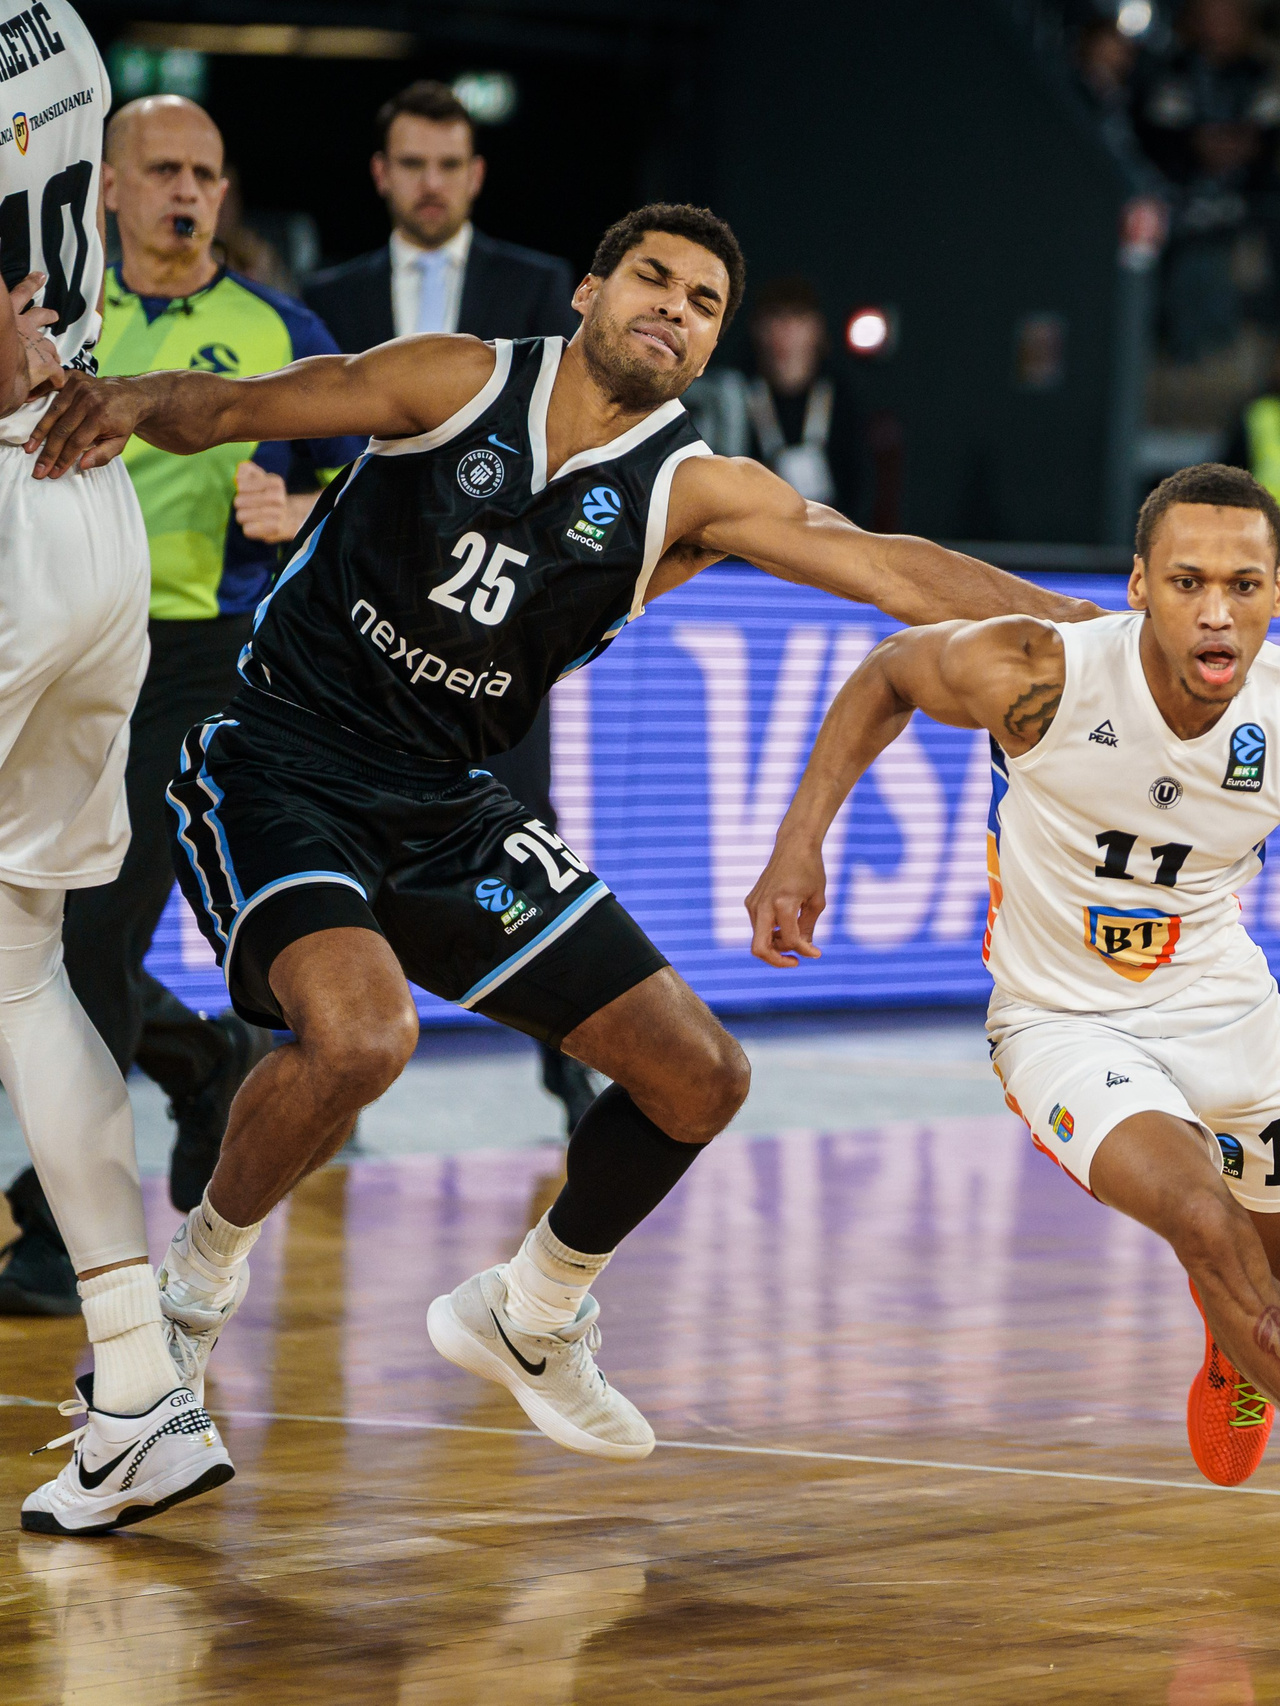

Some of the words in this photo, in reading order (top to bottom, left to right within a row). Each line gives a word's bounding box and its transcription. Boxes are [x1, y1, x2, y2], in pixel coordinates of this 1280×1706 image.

[15, 122, 26, 138] BT
[566, 528, 603, 552] EuroCup
[574, 520, 606, 540] BKT
[428, 531, 530, 626] 25
[351, 598, 512, 699] nexpera
[1088, 732, 1119, 748] PEAK
[1226, 778, 1261, 789] EuroCup
[1233, 766, 1259, 777] BKT
[1158, 785, 1175, 802] U
[503, 818, 590, 894] 25
[1095, 830, 1193, 888] 11
[501, 900, 527, 926] BKT
[504, 907, 537, 935] EuroCup
[1102, 921, 1163, 954] BT
